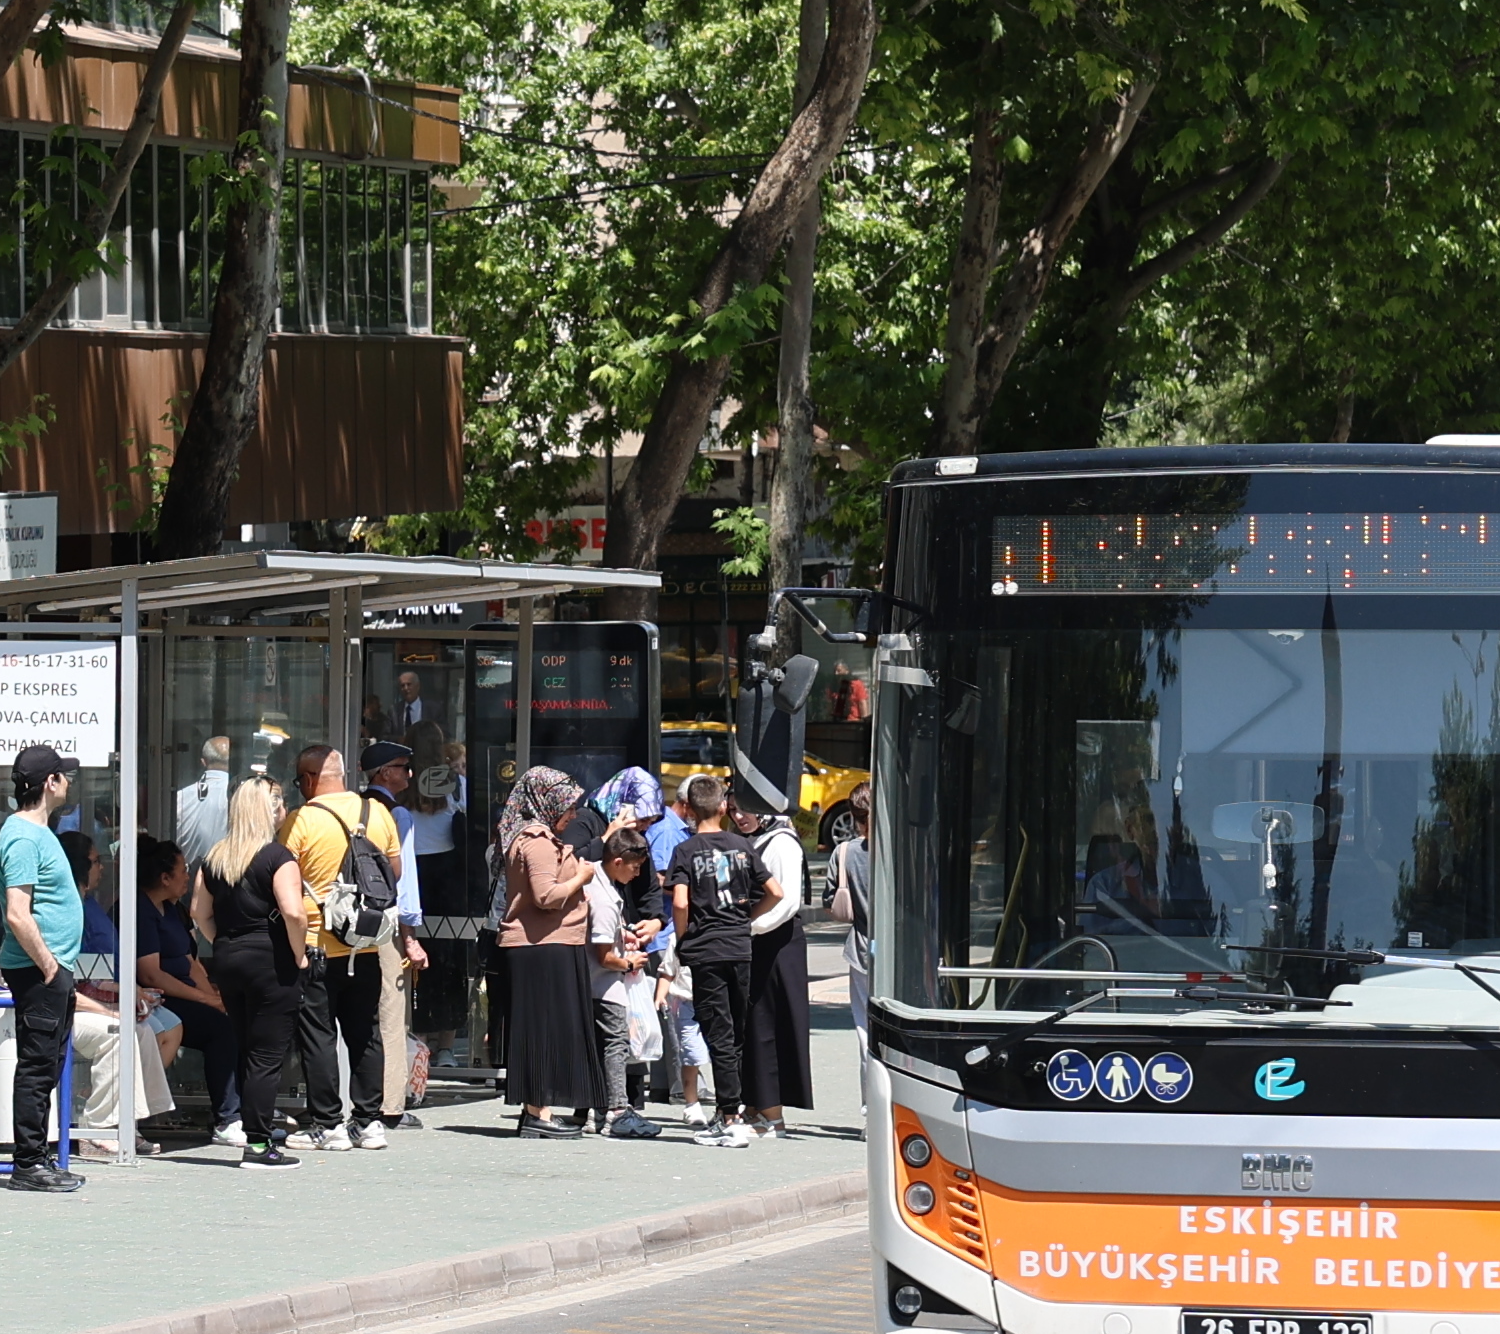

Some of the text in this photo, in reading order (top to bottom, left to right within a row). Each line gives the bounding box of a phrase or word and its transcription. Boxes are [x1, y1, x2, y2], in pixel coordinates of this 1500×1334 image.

[541, 655, 567, 667] ODP
[609, 655, 617, 667] 9
[619, 655, 633, 667] dk
[13, 682, 78, 697] EKSPRES
[1241, 1153, 1314, 1192] BMC
[1179, 1199, 1398, 1245] ESKİŞEHİR
[1018, 1242, 1280, 1289] BÜYÜKŞEHİR
